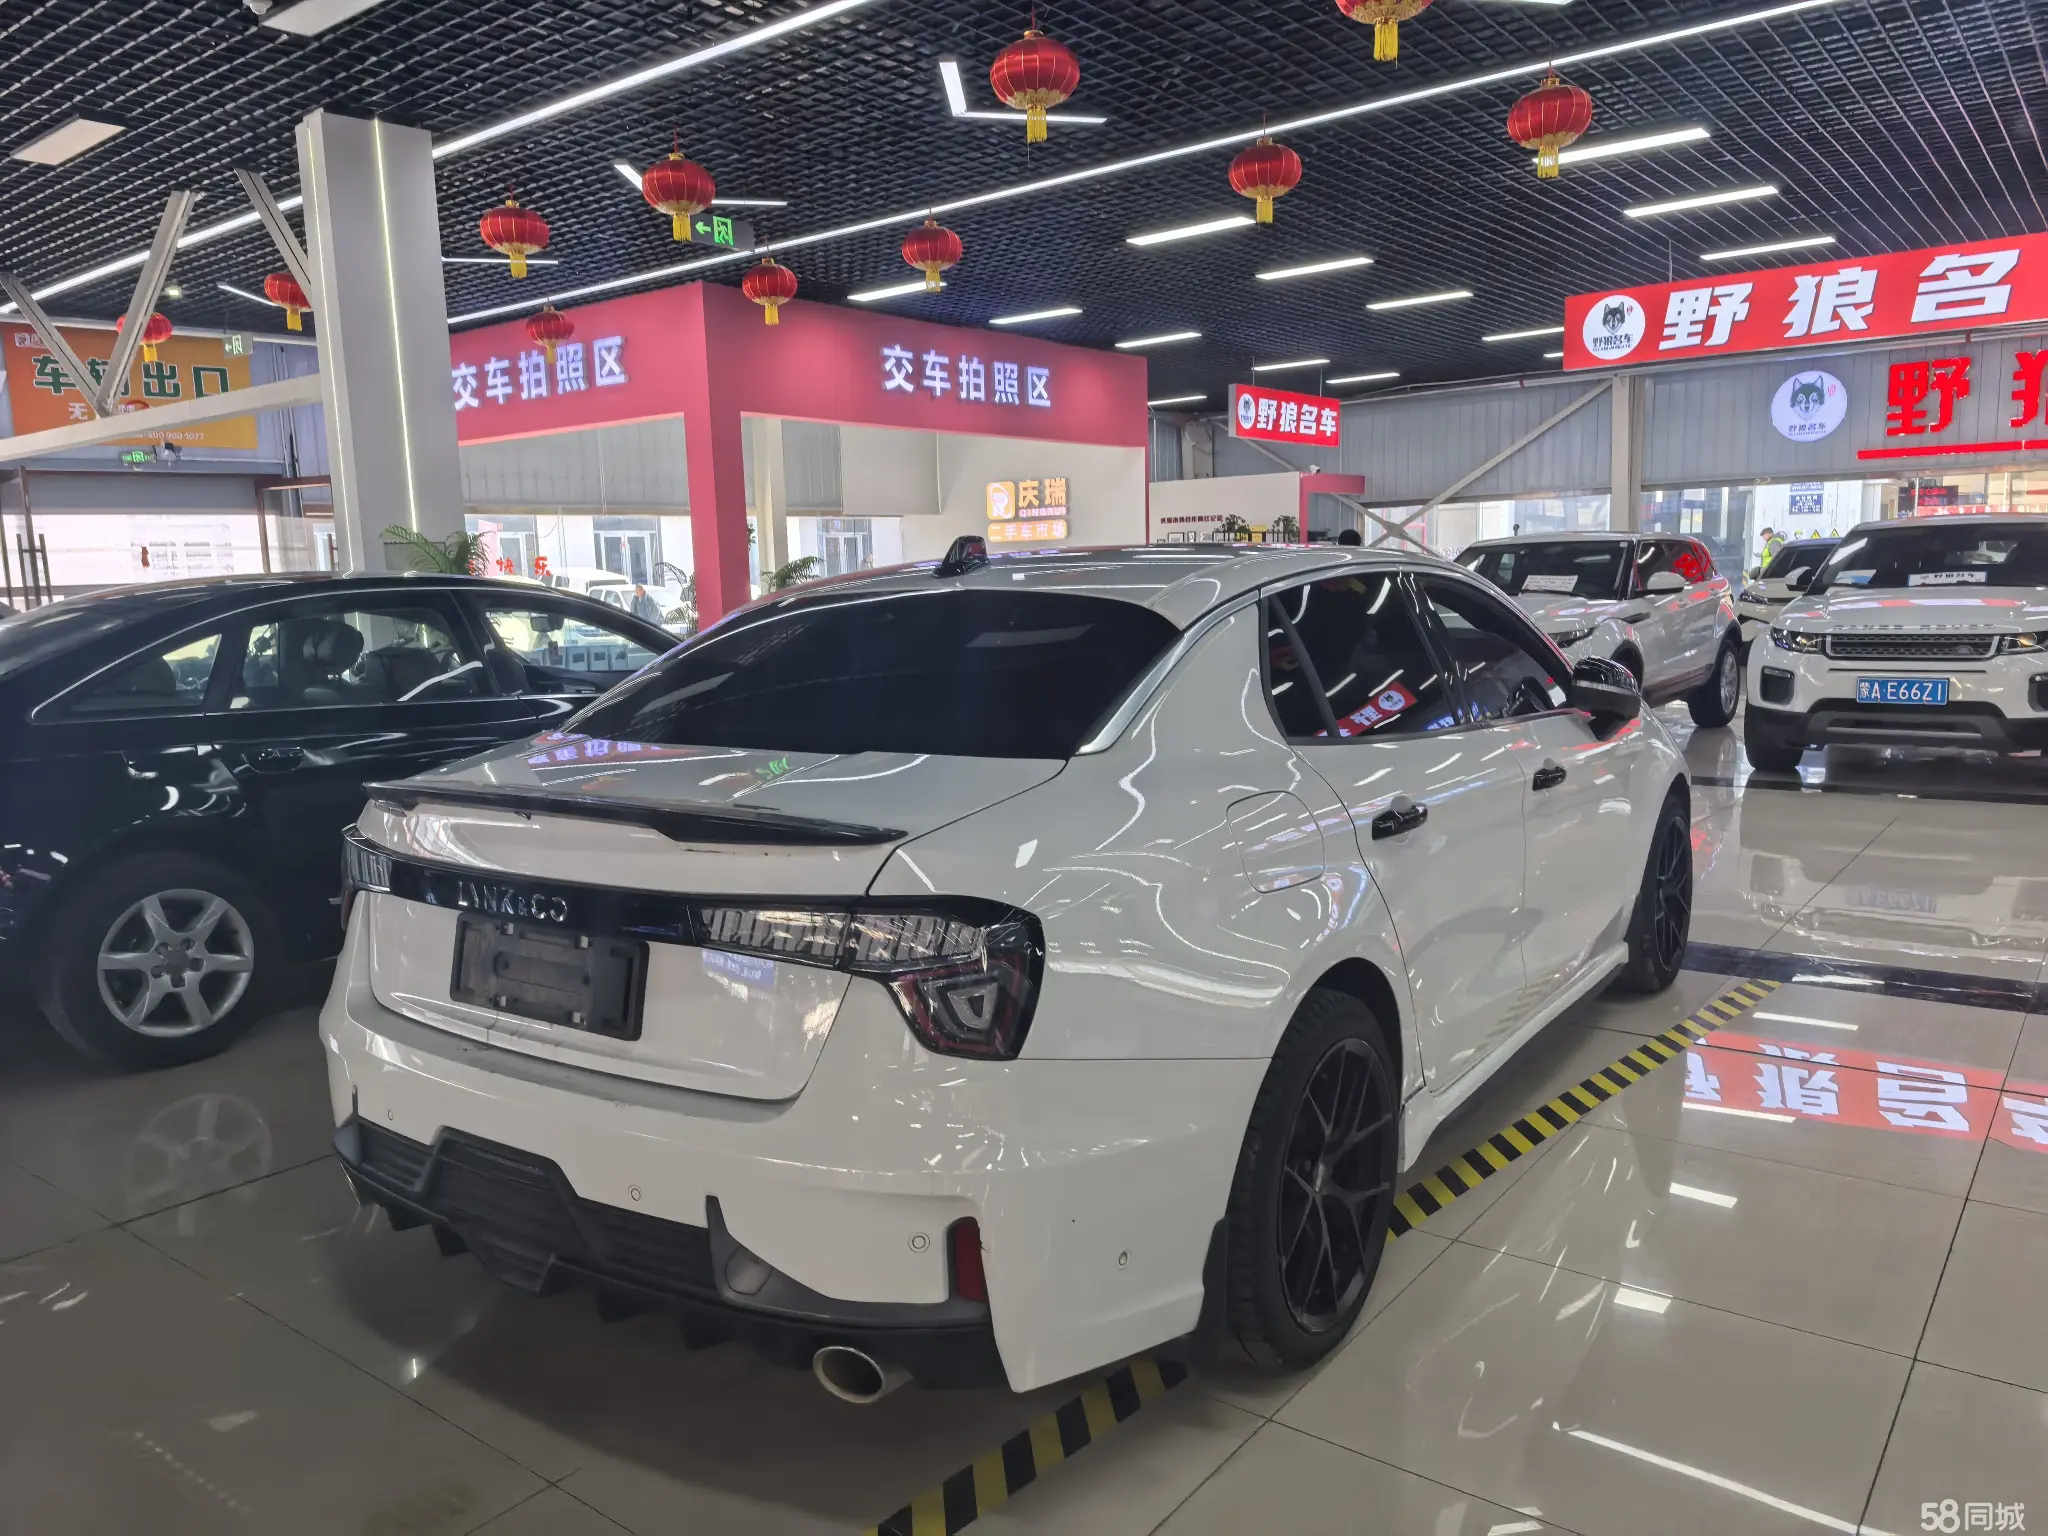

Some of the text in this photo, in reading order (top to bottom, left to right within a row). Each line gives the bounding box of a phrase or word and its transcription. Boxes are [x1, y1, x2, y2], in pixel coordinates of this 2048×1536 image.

[1658, 248, 2021, 351] 野狼名
[452, 335, 628, 410] 交车拍照区
[882, 344, 1052, 408] 交车拍照区
[1257, 398, 1337, 436] 野狼名车
[1018, 477, 1066, 508] 庆瑞
[991, 520, 1065, 541] 二手车市场
